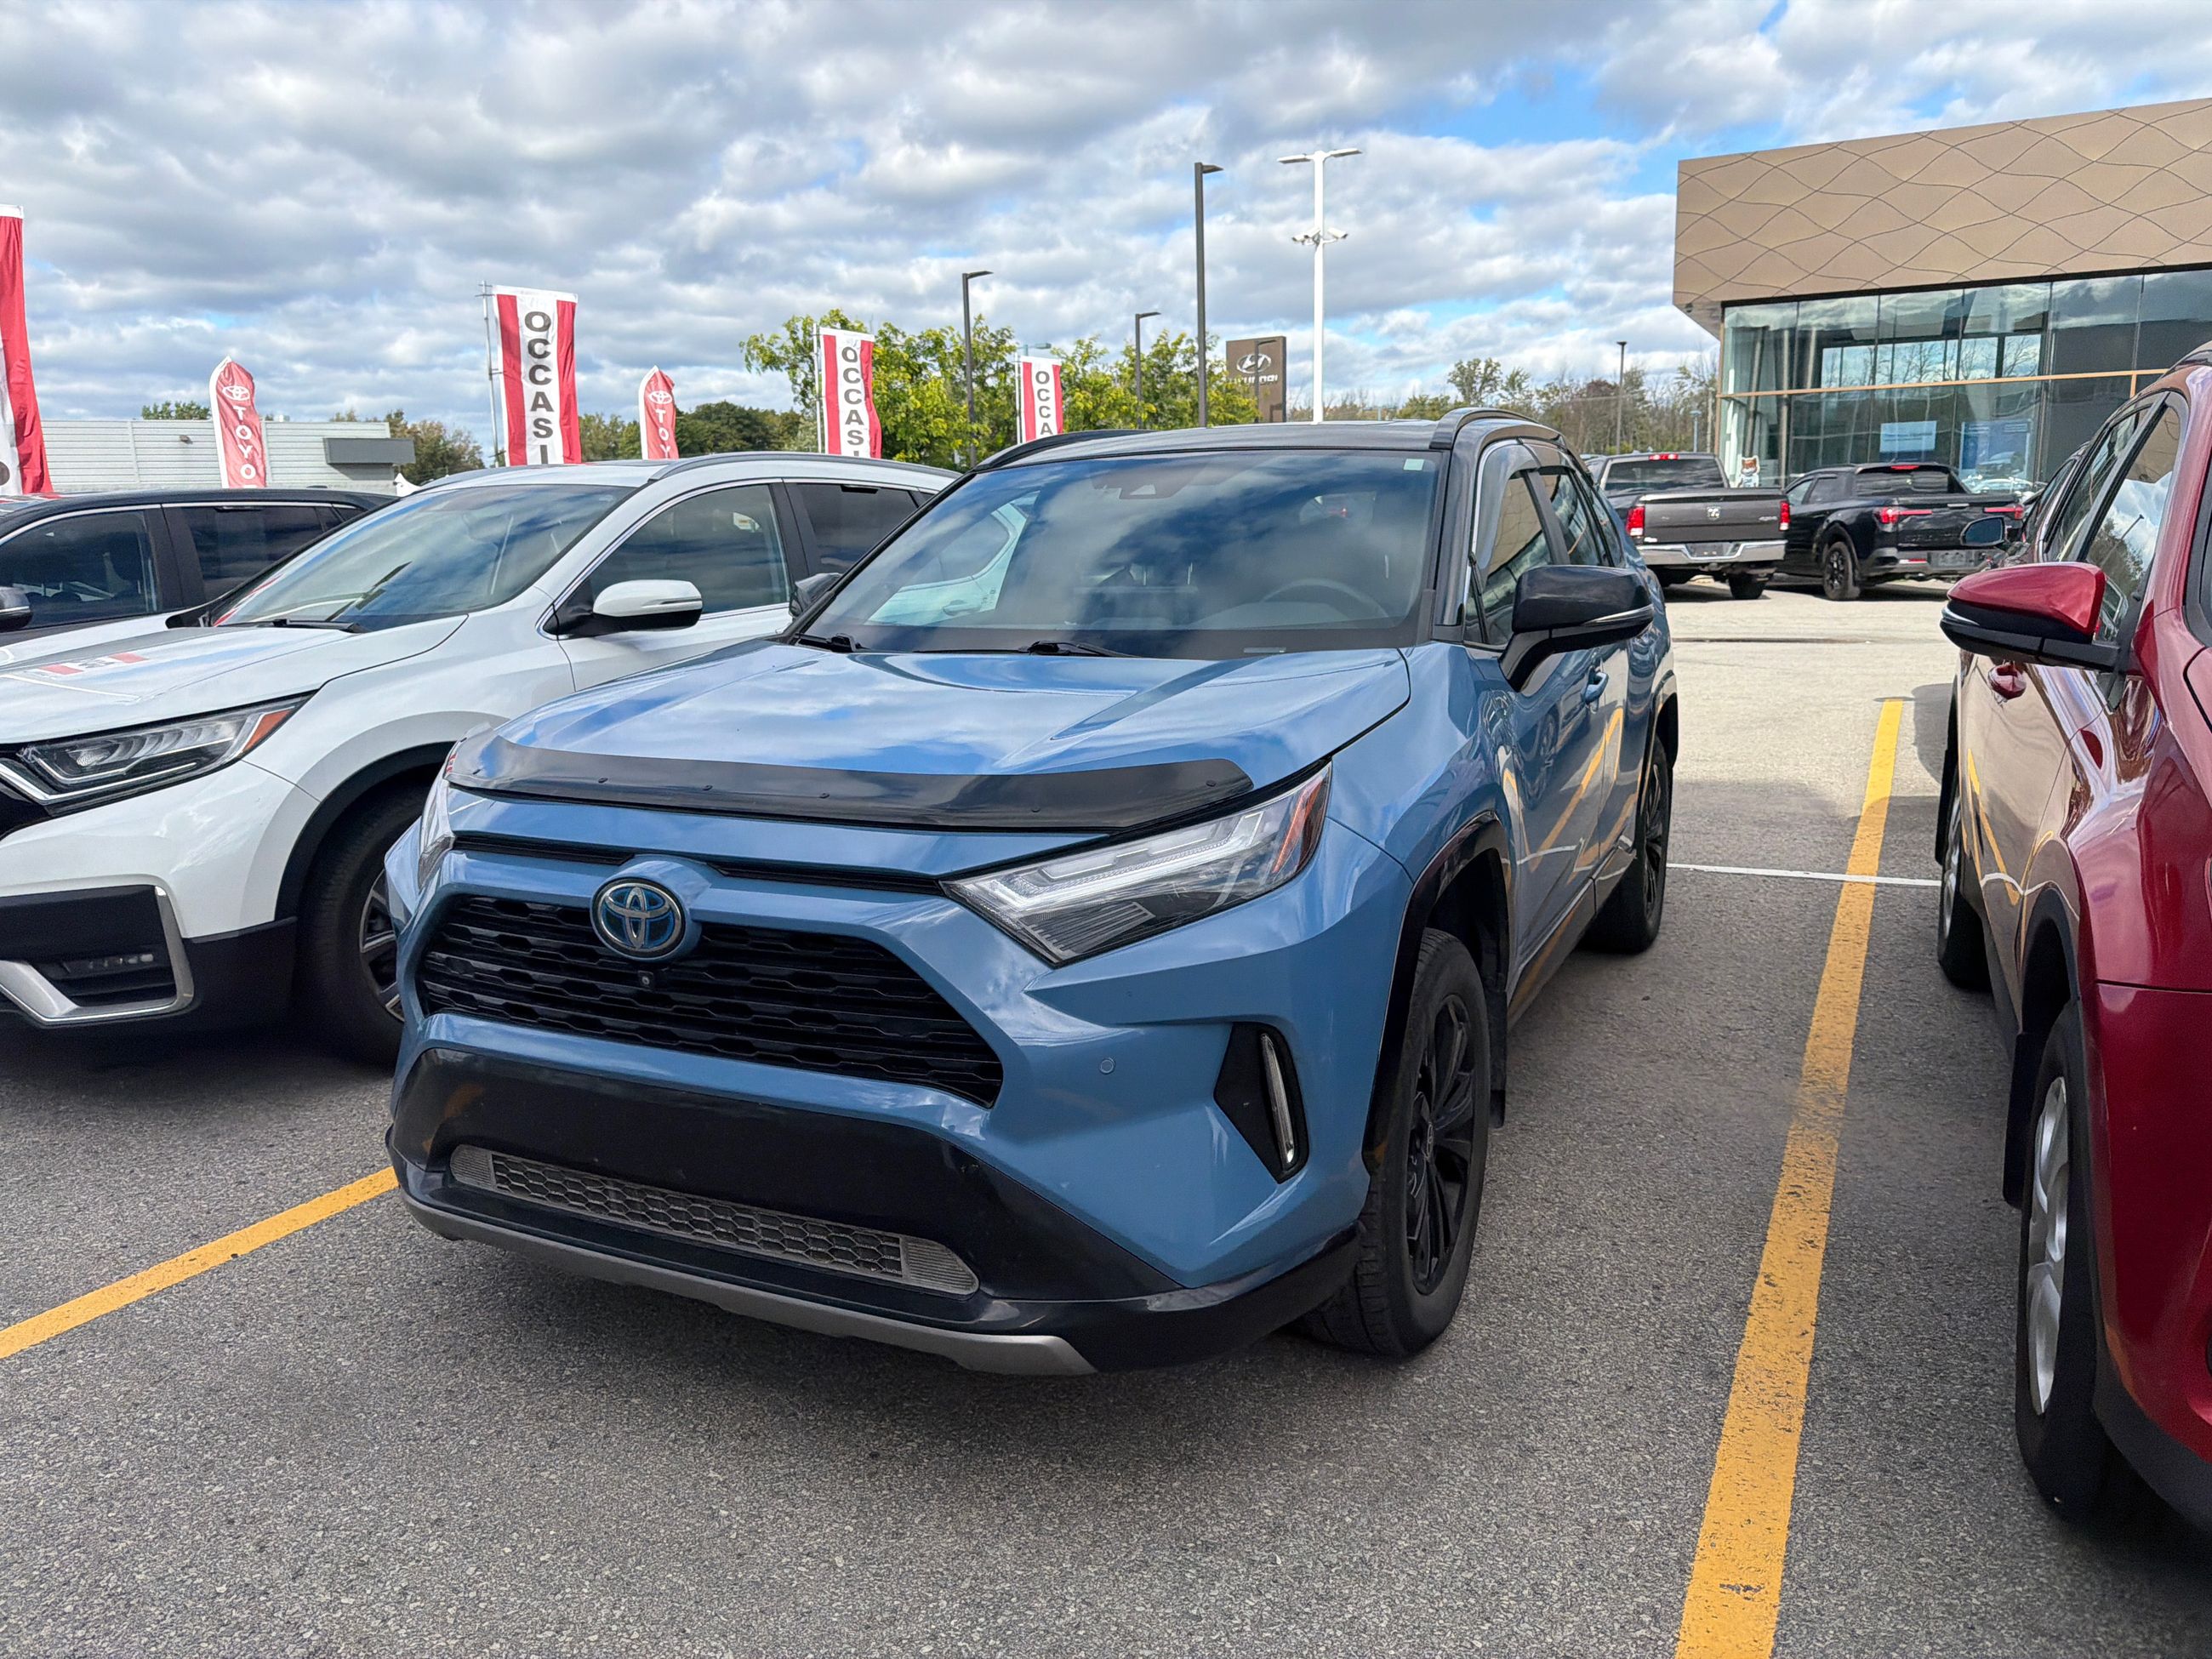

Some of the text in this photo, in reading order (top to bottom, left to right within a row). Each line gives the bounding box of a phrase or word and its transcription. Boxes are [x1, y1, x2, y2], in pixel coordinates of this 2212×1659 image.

[524, 311, 555, 465] OCCASI
[1035, 370, 1053, 436] OCCA
[233, 406, 256, 488] TOYO
